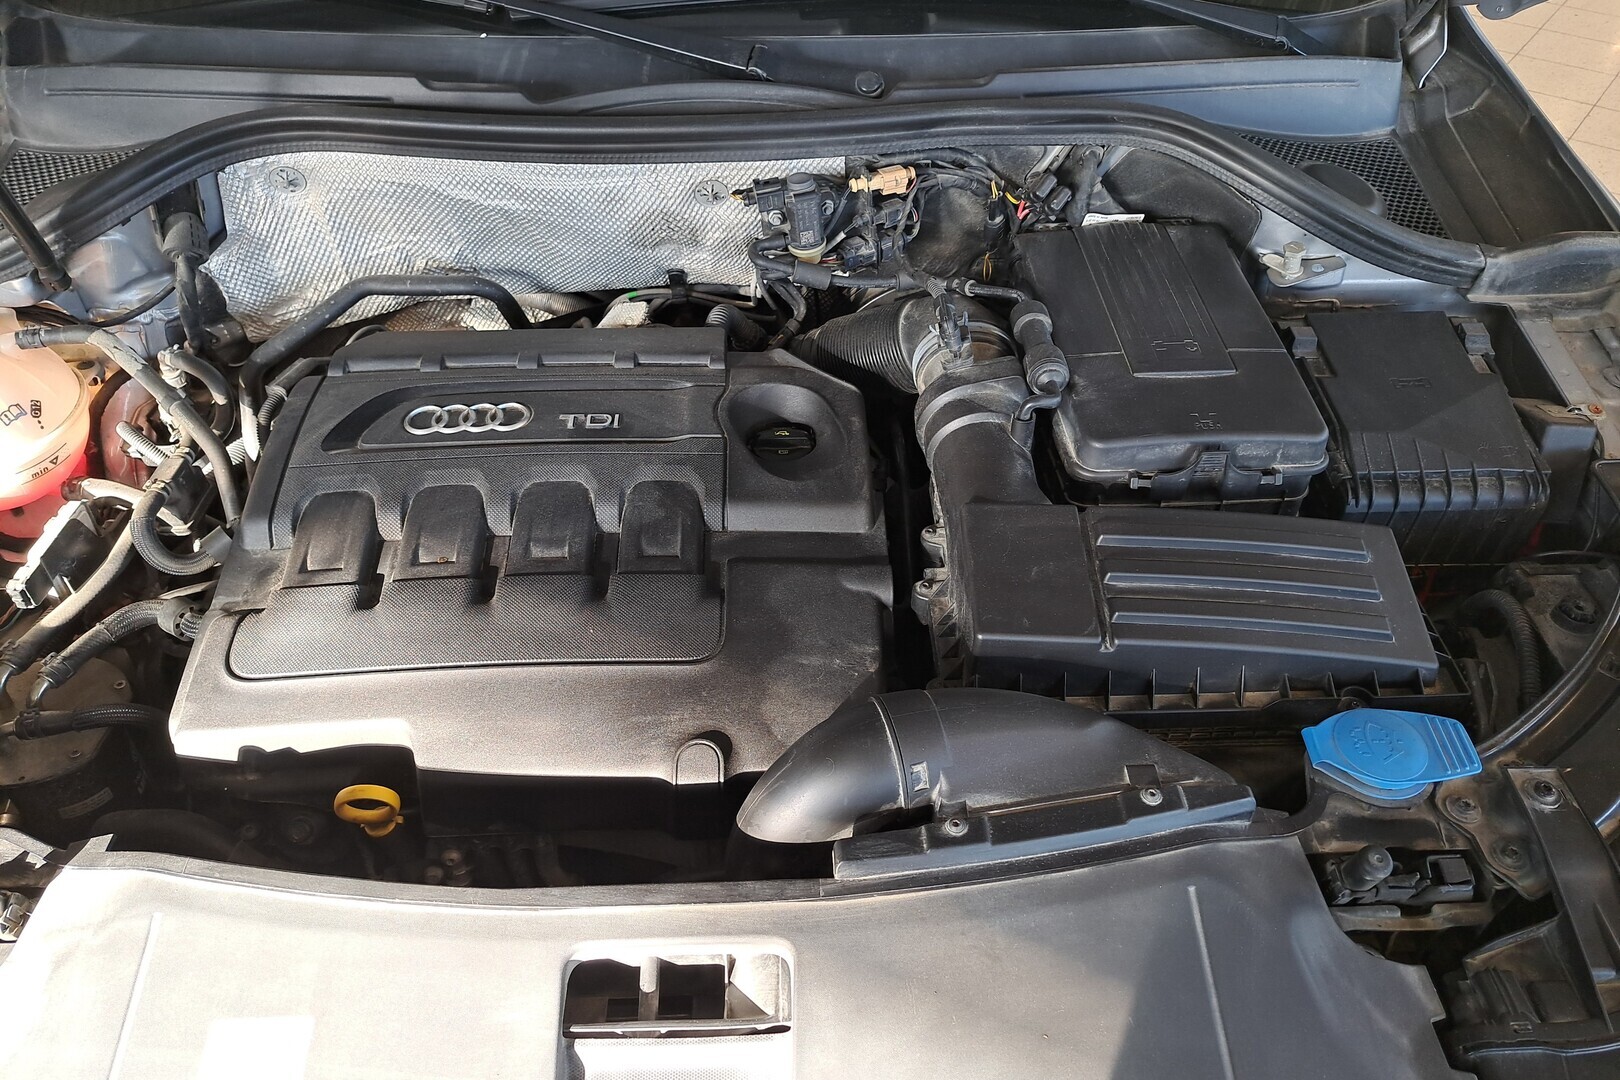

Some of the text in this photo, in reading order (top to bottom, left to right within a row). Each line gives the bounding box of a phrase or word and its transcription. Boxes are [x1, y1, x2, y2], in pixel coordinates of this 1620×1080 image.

[31, 400, 41, 417] G12
[559, 413, 620, 430] TDI
[31, 466, 49, 478] min
